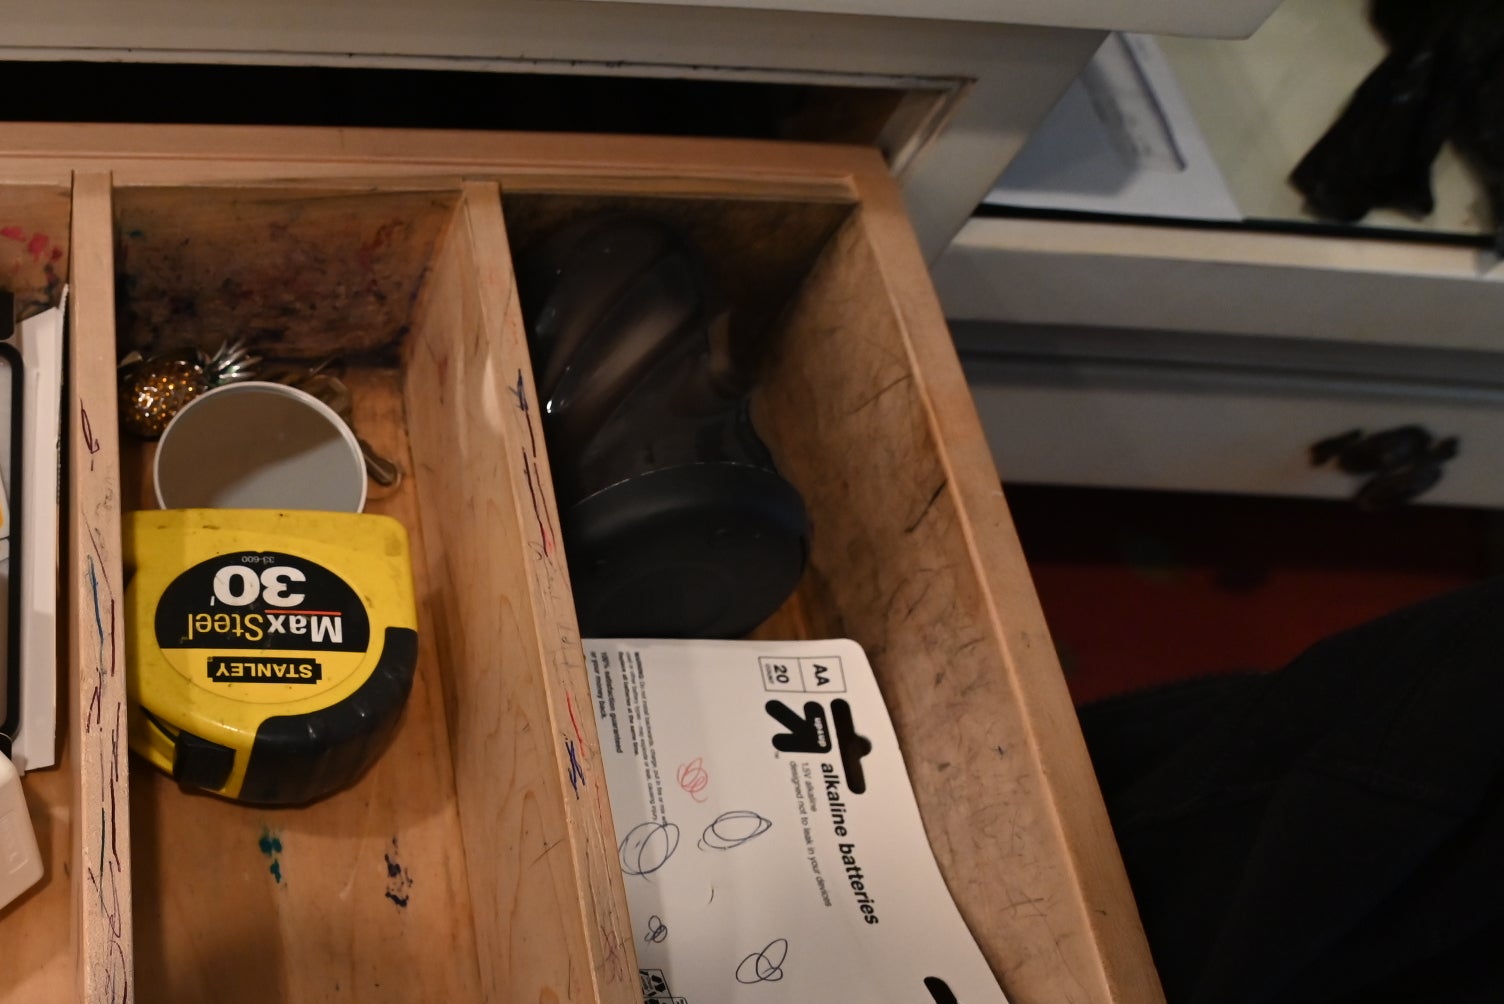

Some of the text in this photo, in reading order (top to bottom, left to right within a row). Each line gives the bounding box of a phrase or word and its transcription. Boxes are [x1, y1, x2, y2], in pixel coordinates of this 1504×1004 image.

[242, 555, 275, 564] 33-600
[188, 613, 343, 643] MaxSteel
[216, 663, 312, 679] STANLEY
[774, 665, 789, 683] 20
[814, 664, 830, 686] AA
[821, 764, 878, 924] alkaline batteries
